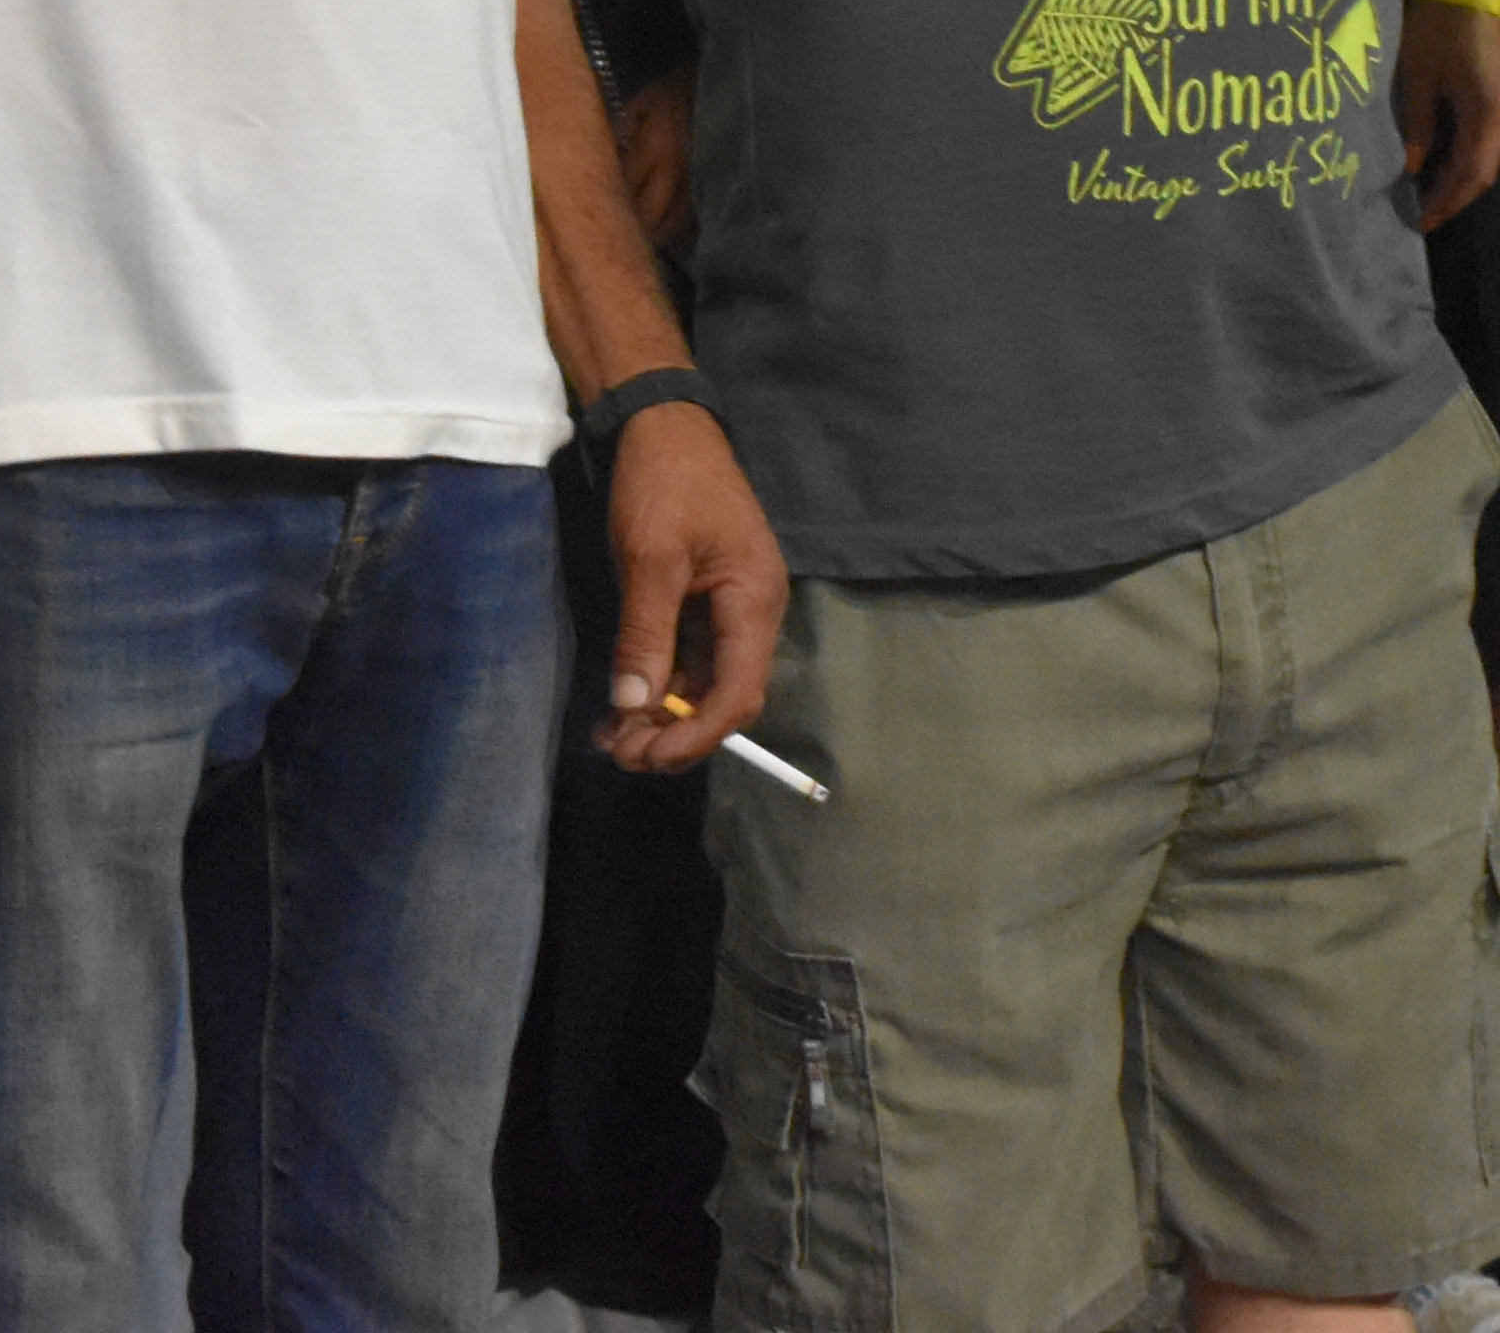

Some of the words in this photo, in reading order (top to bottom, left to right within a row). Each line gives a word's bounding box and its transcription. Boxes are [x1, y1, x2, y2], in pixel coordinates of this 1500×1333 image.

[1122, 26, 1342, 138] Nomads
[1067, 147, 1200, 221] Vintage
[1217, 138, 1306, 209] Surf
